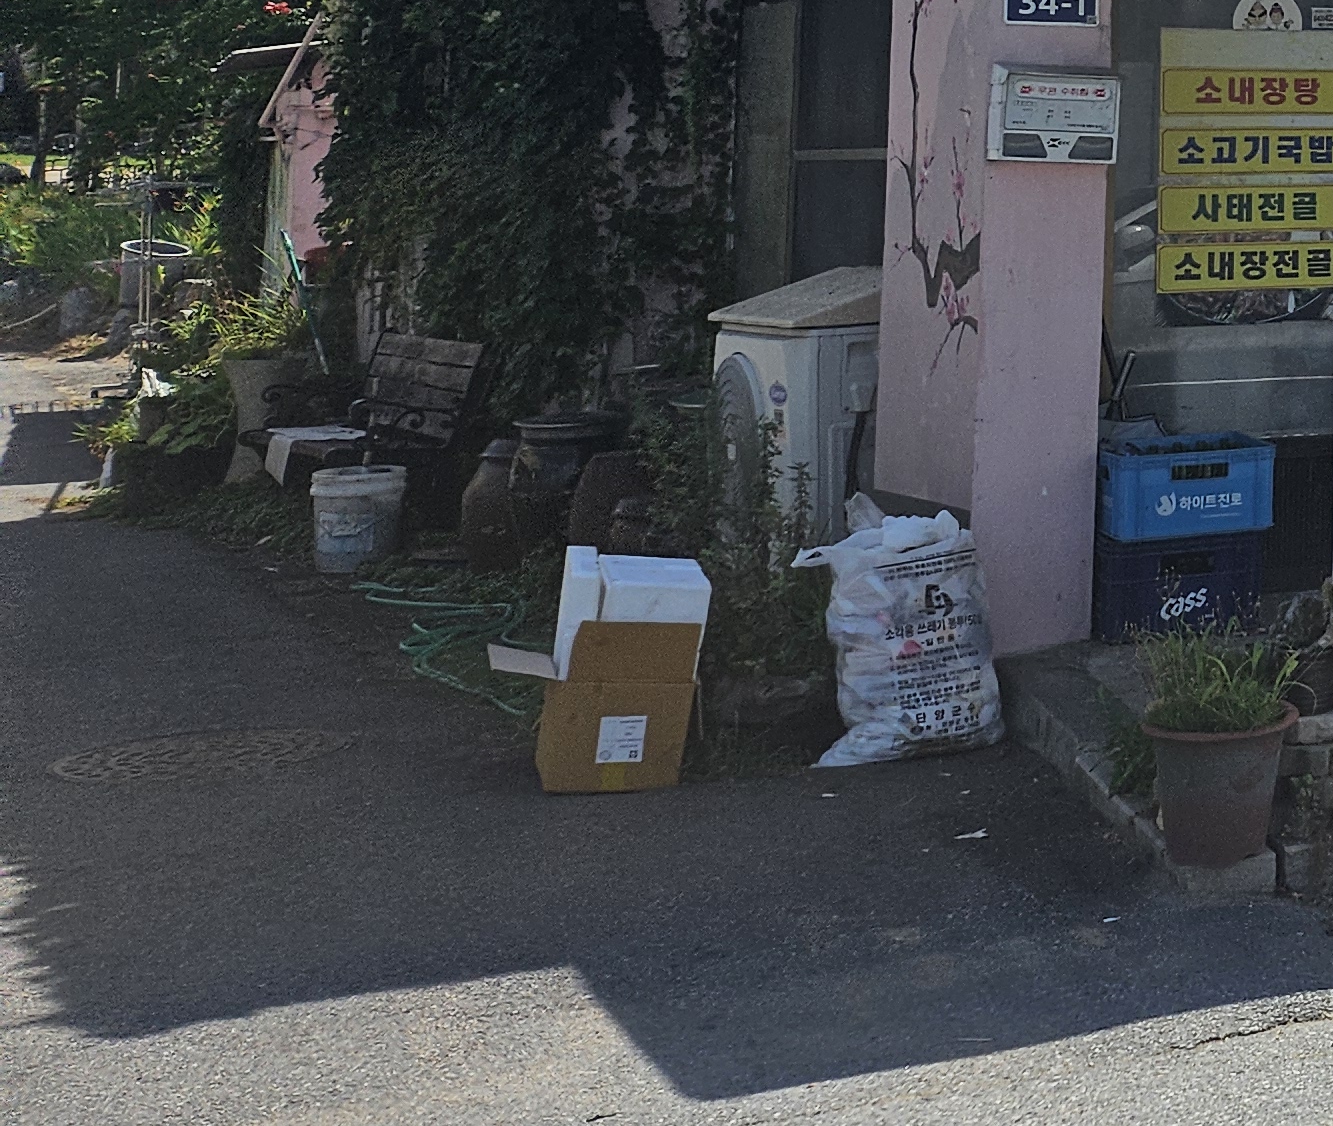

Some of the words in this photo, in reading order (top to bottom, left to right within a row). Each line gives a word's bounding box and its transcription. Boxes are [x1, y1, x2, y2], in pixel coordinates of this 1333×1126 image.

[1195, 76, 1320, 105] 소내장탕
[1192, 192, 1317, 222] 사태전골
[1174, 249, 1331, 281] 소내장전골
[1179, 492, 1243, 510] 하이트진로
